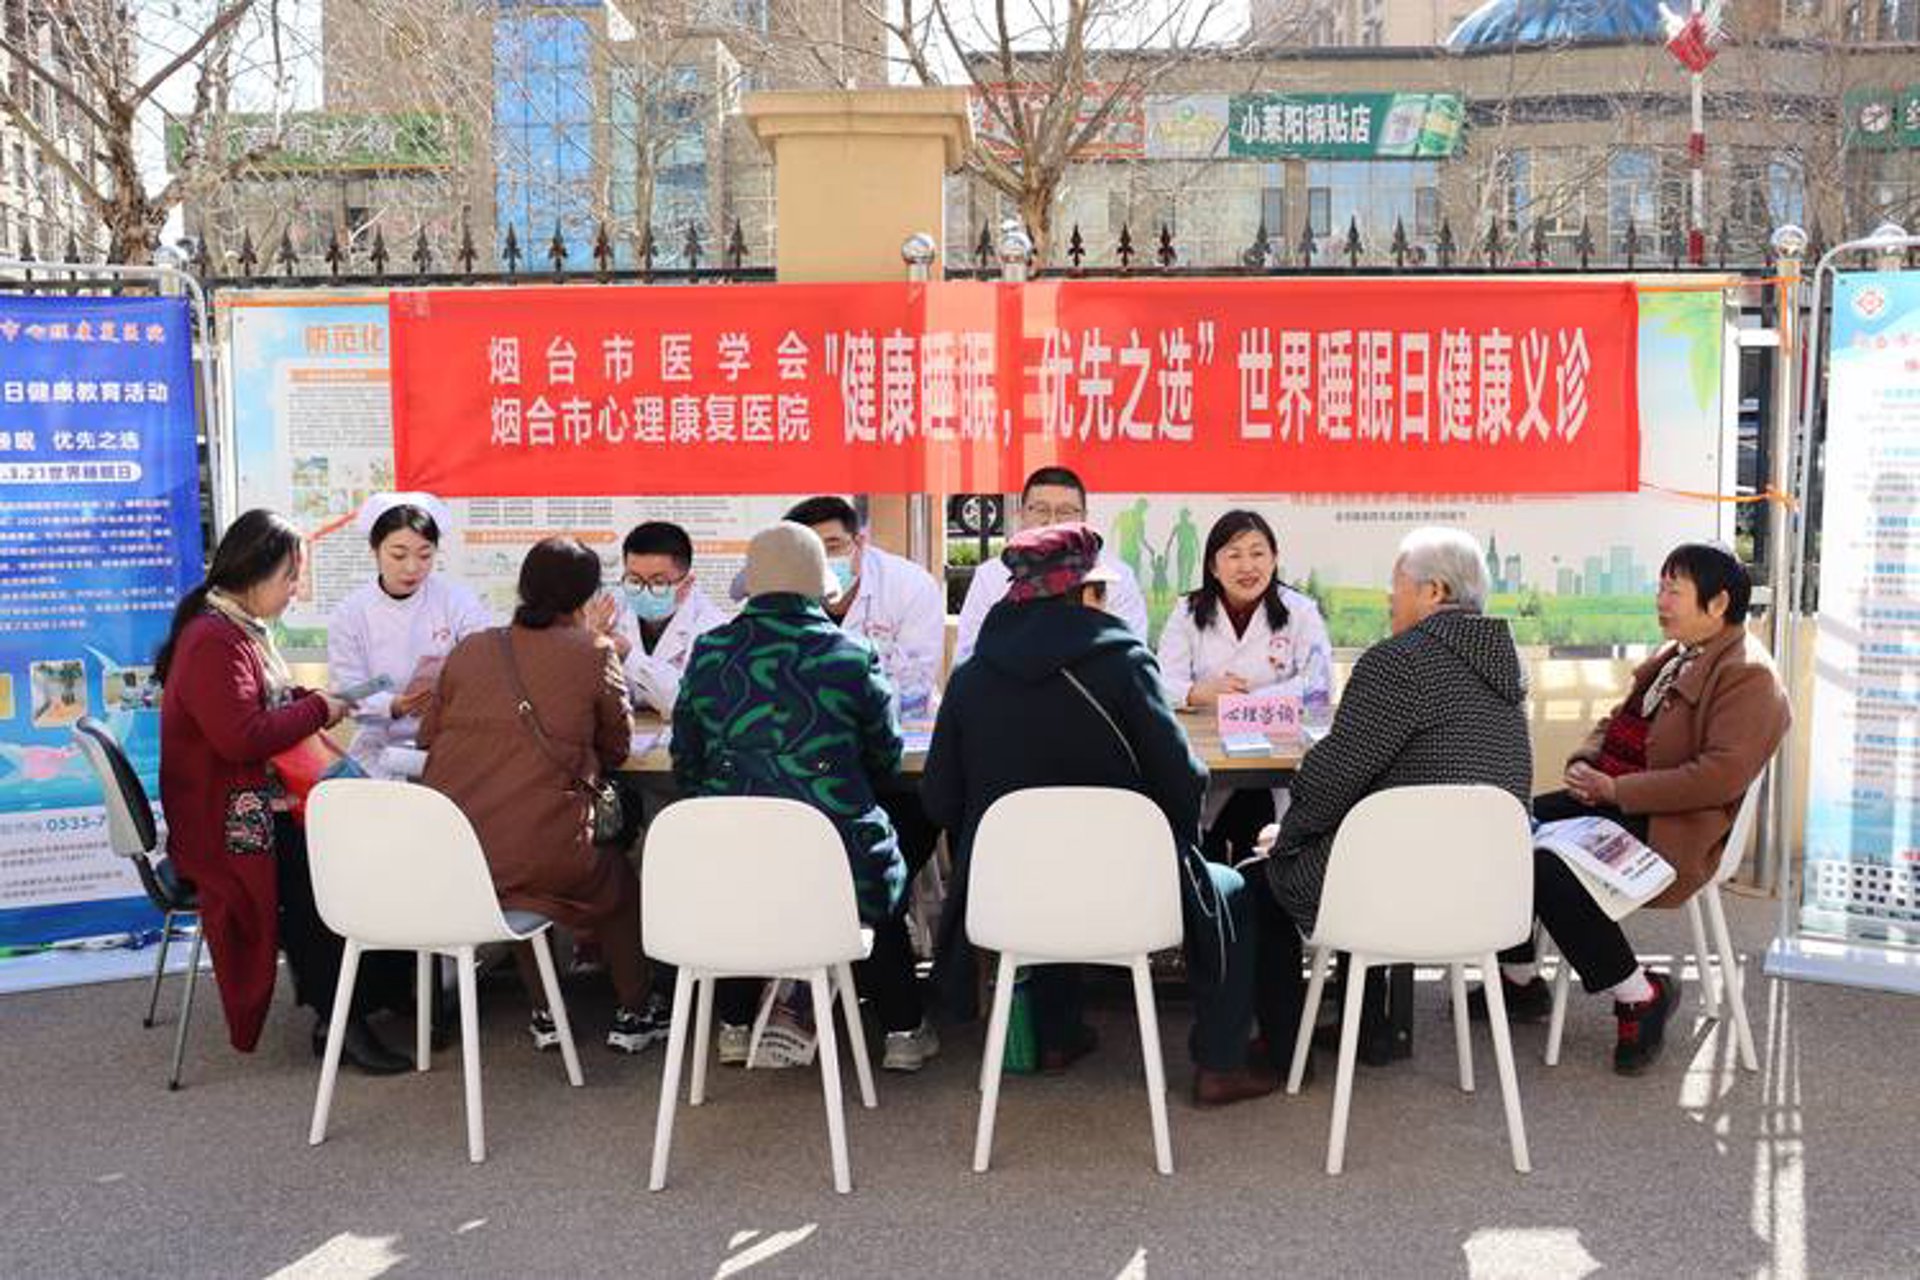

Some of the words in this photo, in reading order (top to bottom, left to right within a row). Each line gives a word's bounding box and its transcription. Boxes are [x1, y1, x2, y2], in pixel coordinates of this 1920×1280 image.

[1240, 103, 1373, 145] 小莱阳锅贴店
[488, 332, 810, 385] 烟台市医学会
[4, 380, 169, 404] 日健康教育活动
[52, 430, 141, 451] 优先之选
